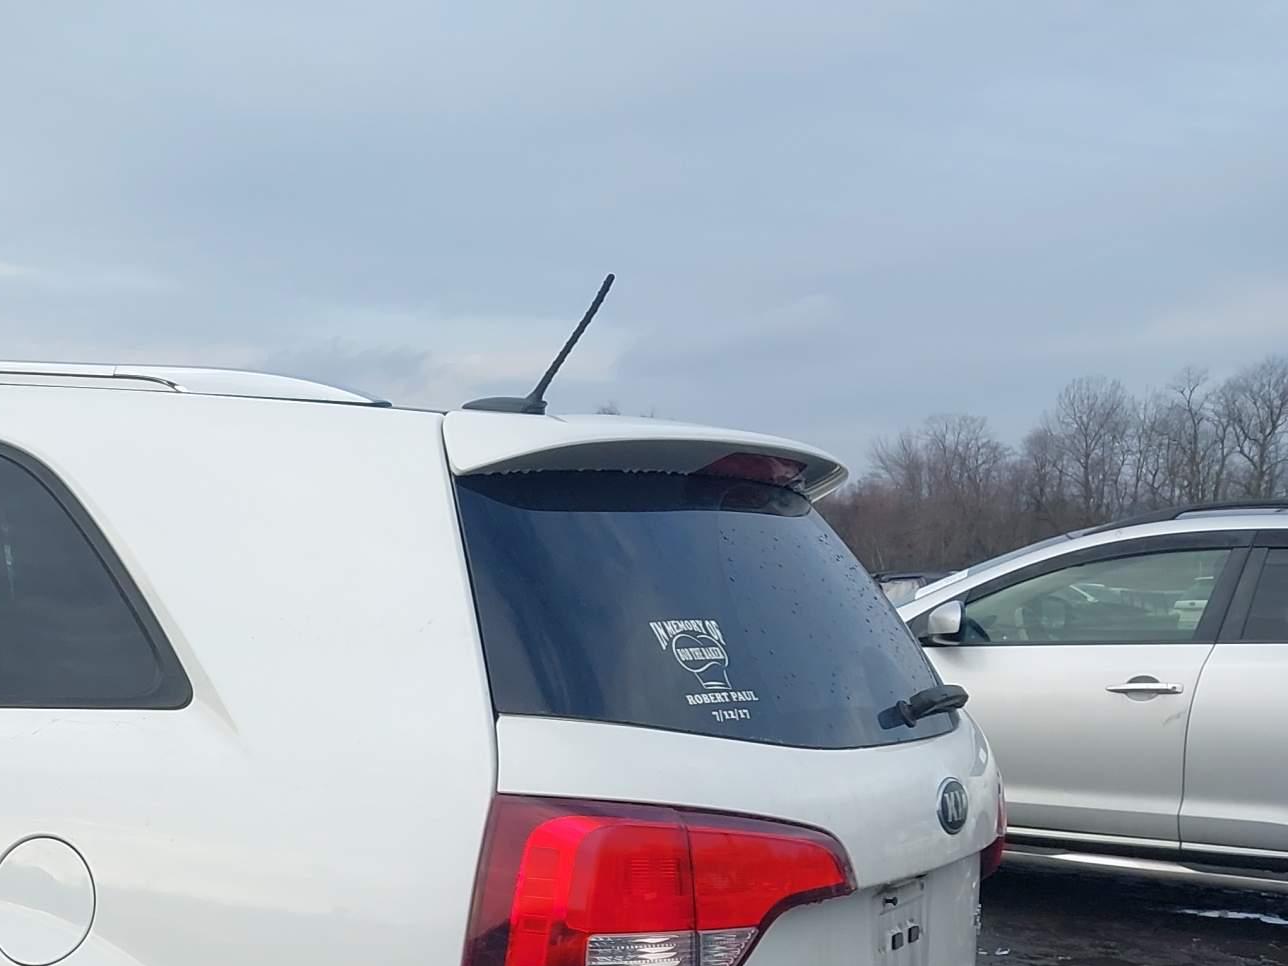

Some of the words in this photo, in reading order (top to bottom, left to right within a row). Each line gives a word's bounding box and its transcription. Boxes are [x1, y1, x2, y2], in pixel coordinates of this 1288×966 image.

[649, 621, 669, 650] IN
[664, 619, 707, 638] MEMORY
[705, 619, 727, 645] OF
[686, 691, 730, 705] ROBERT
[729, 690, 759, 702] PAUL
[712, 708, 751, 722] 7/12/17
